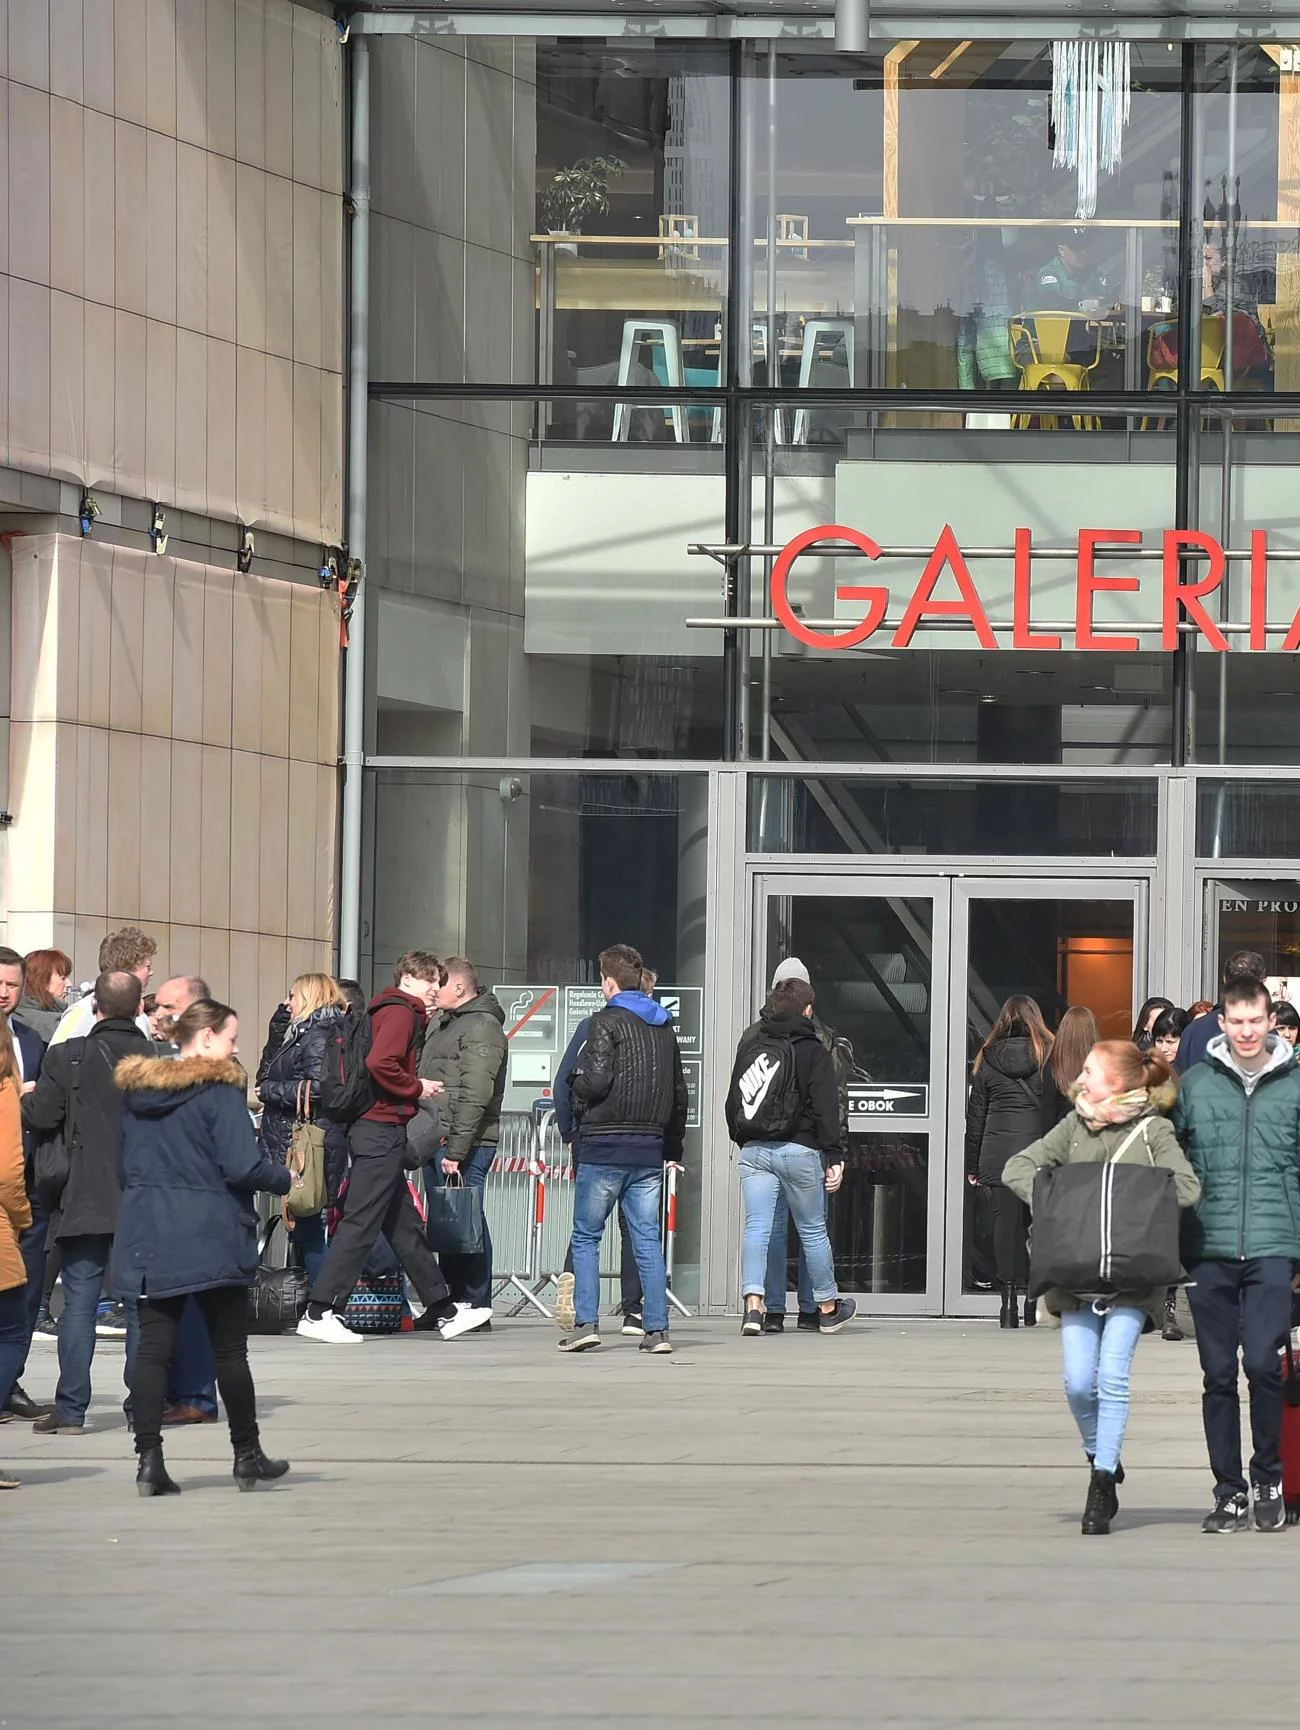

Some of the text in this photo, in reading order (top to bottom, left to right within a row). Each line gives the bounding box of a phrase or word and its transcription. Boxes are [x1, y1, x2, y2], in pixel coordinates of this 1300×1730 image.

[1221, 900, 1247, 912] EN
[739, 1053, 770, 1103] NIKE
[858, 1100, 895, 1111] OBOK
